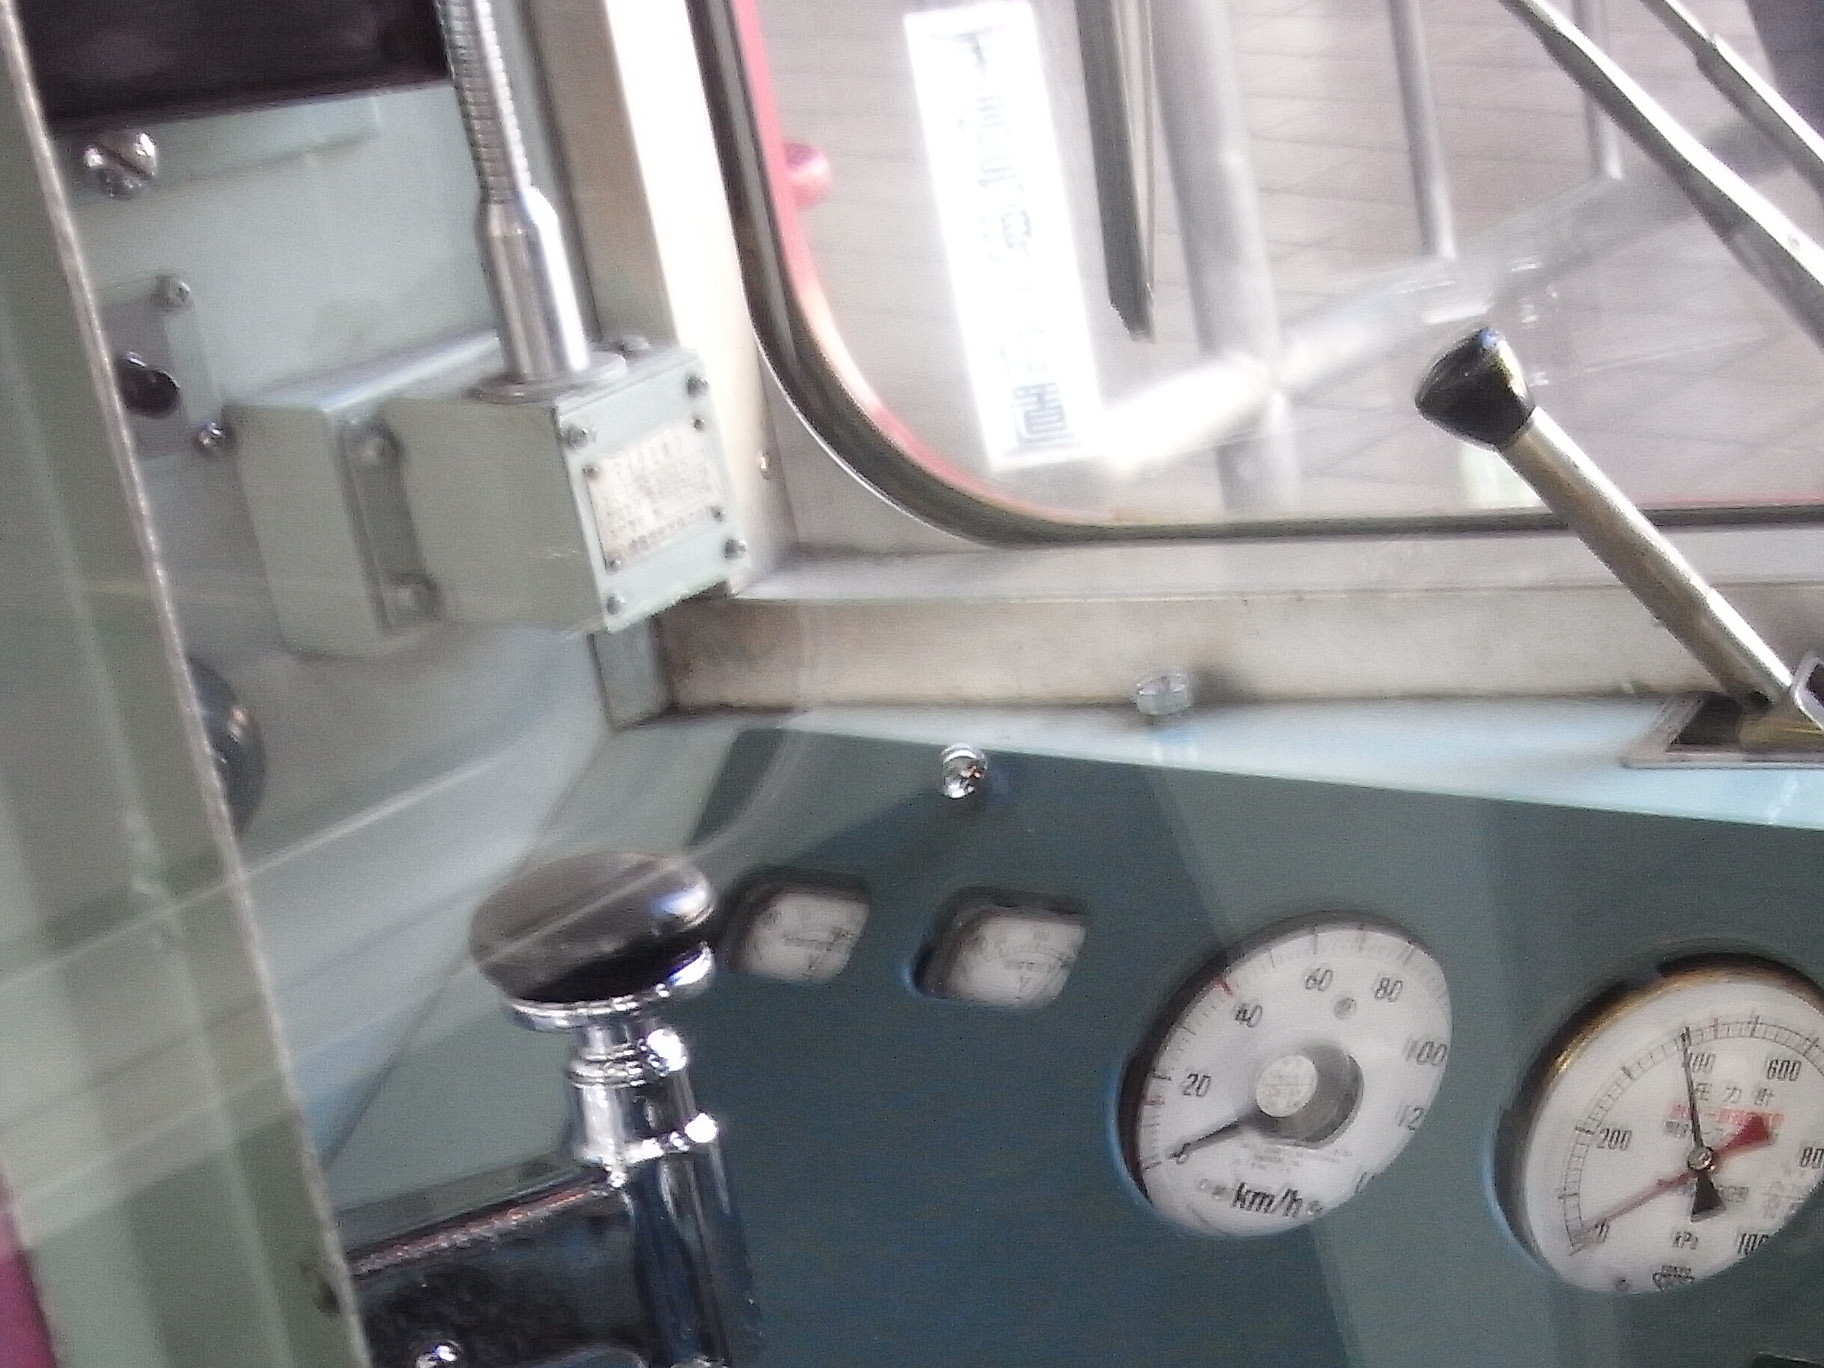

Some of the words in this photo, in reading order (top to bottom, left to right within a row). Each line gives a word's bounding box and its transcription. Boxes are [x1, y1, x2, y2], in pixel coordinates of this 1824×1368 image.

[1305, 968, 1333, 992] 60
[1375, 976, 1402, 1001] 80
[1235, 1003, 1263, 1027] 40
[1406, 1042, 1447, 1065] 100
[1766, 1059, 1801, 1081] 600
[1182, 1073, 1212, 1097] 20
[1597, 1128, 1632, 1150] 200
[1231, 1182, 1303, 1217] km/h
